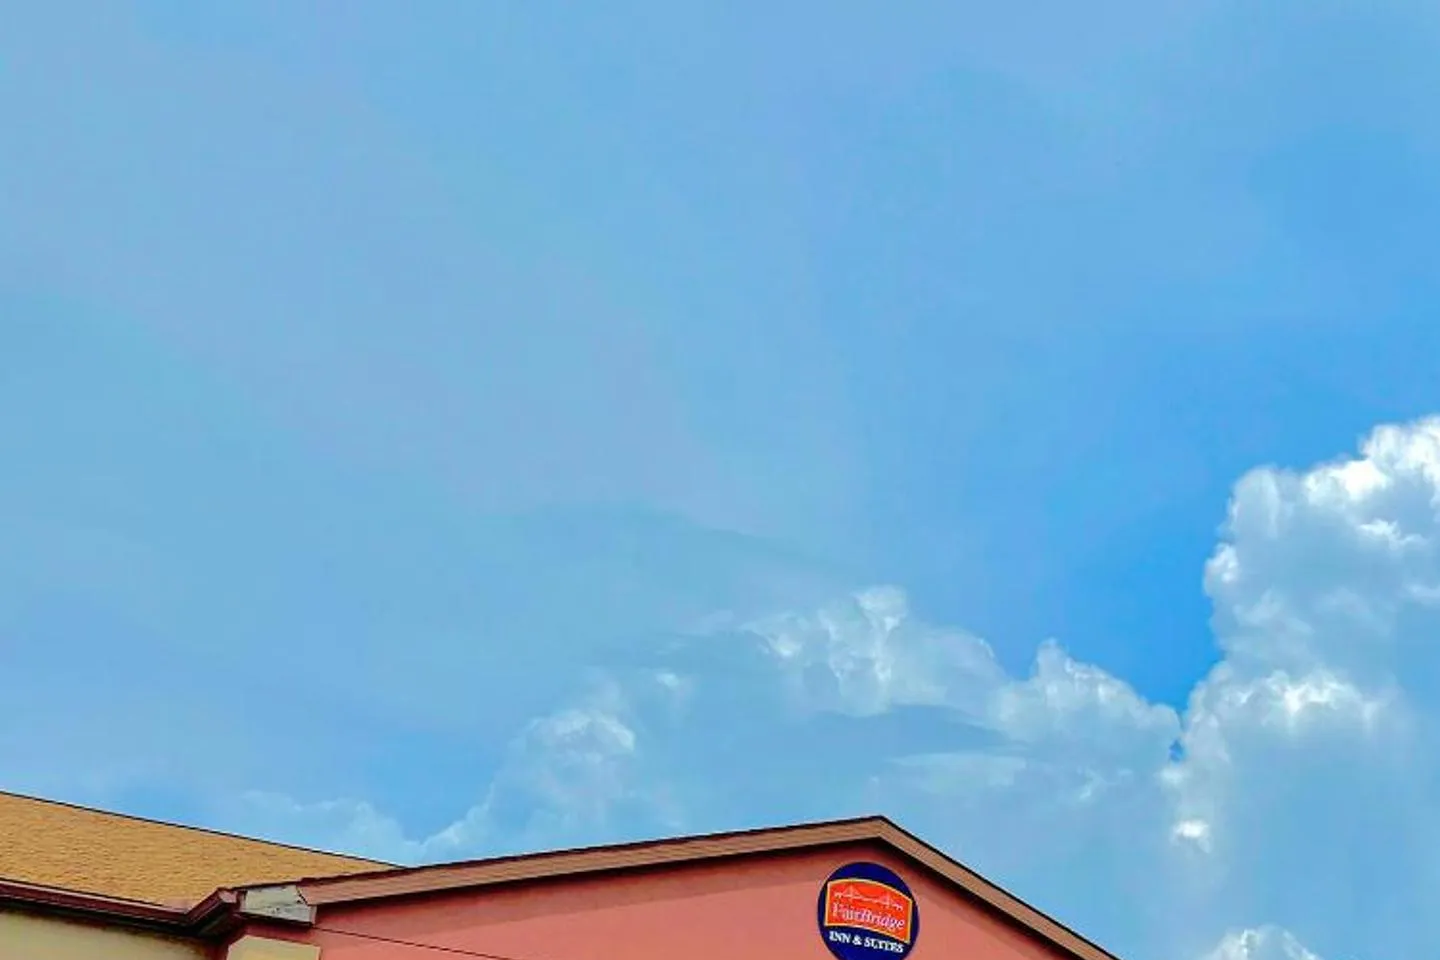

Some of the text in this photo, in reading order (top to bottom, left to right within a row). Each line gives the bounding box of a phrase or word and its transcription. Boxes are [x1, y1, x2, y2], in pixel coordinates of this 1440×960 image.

[832, 901, 905, 933] FairBridge
[829, 931, 904, 953] INN & SUITES
